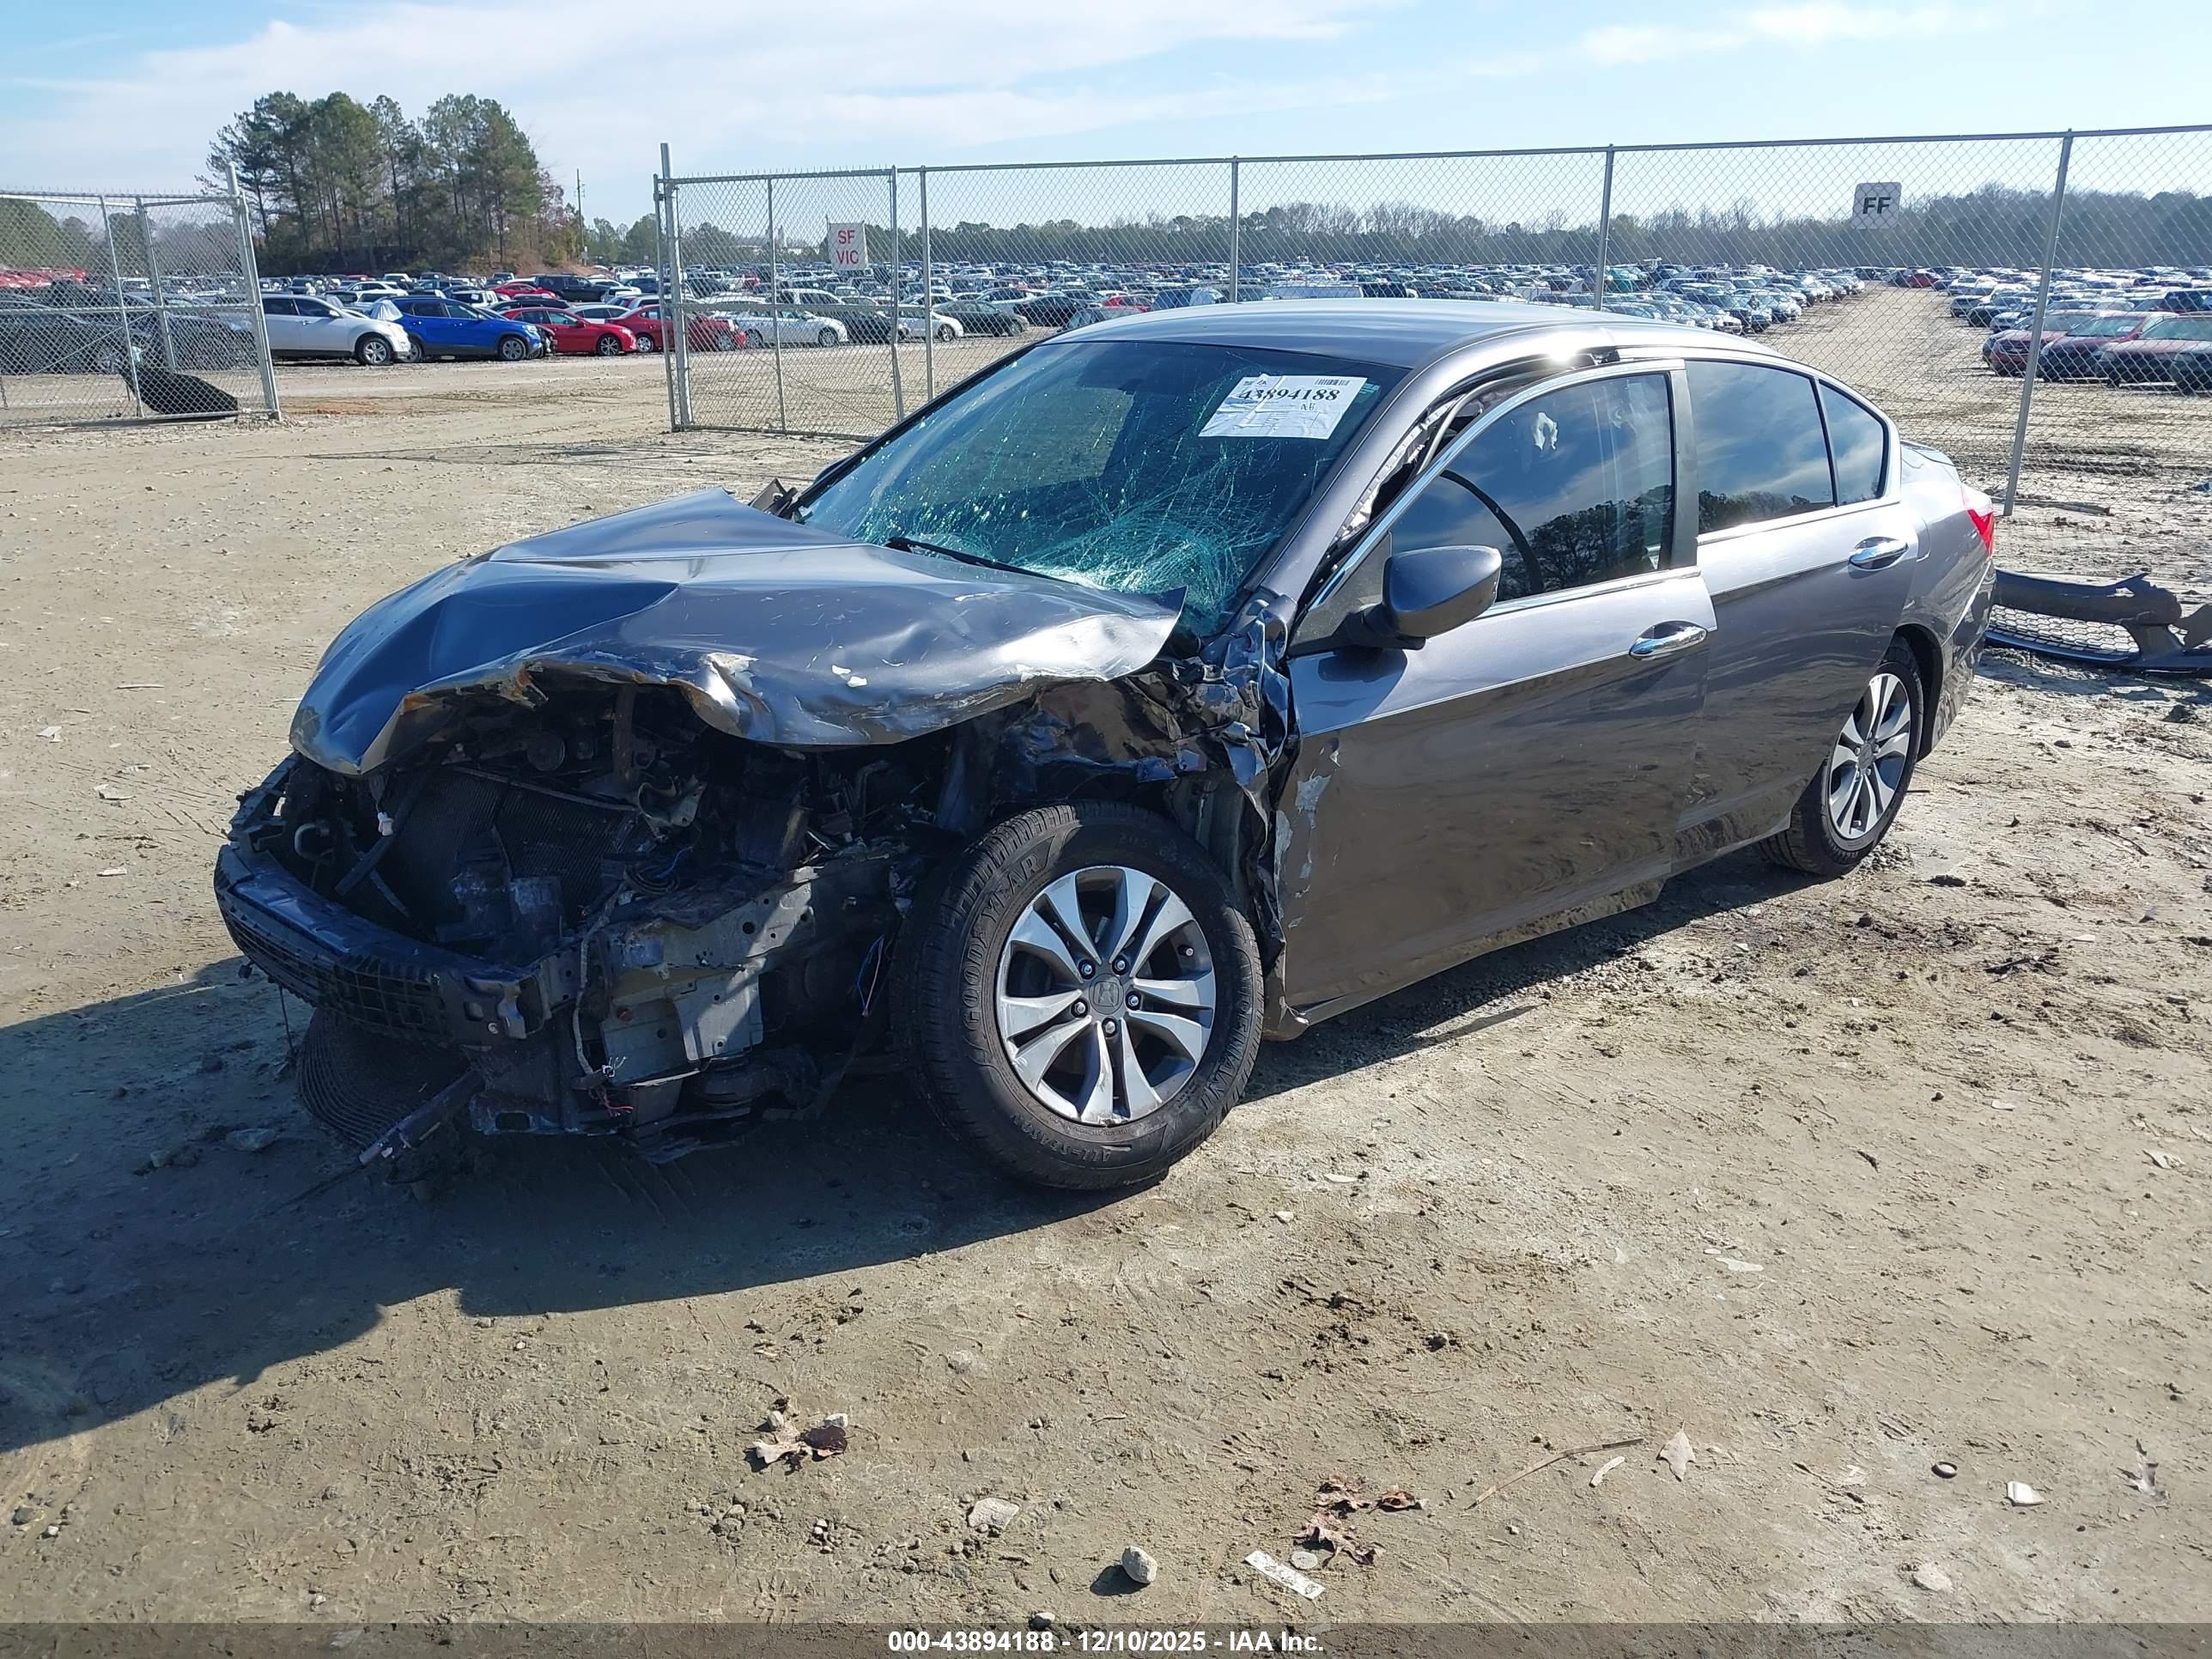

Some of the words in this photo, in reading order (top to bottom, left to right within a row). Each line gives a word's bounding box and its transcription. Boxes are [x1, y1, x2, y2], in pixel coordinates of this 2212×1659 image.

[1863, 197, 1892, 214] FF
[838, 230, 855, 244] SF
[836, 250, 859, 264] VIC
[1238, 388, 1340, 401] 43894188
